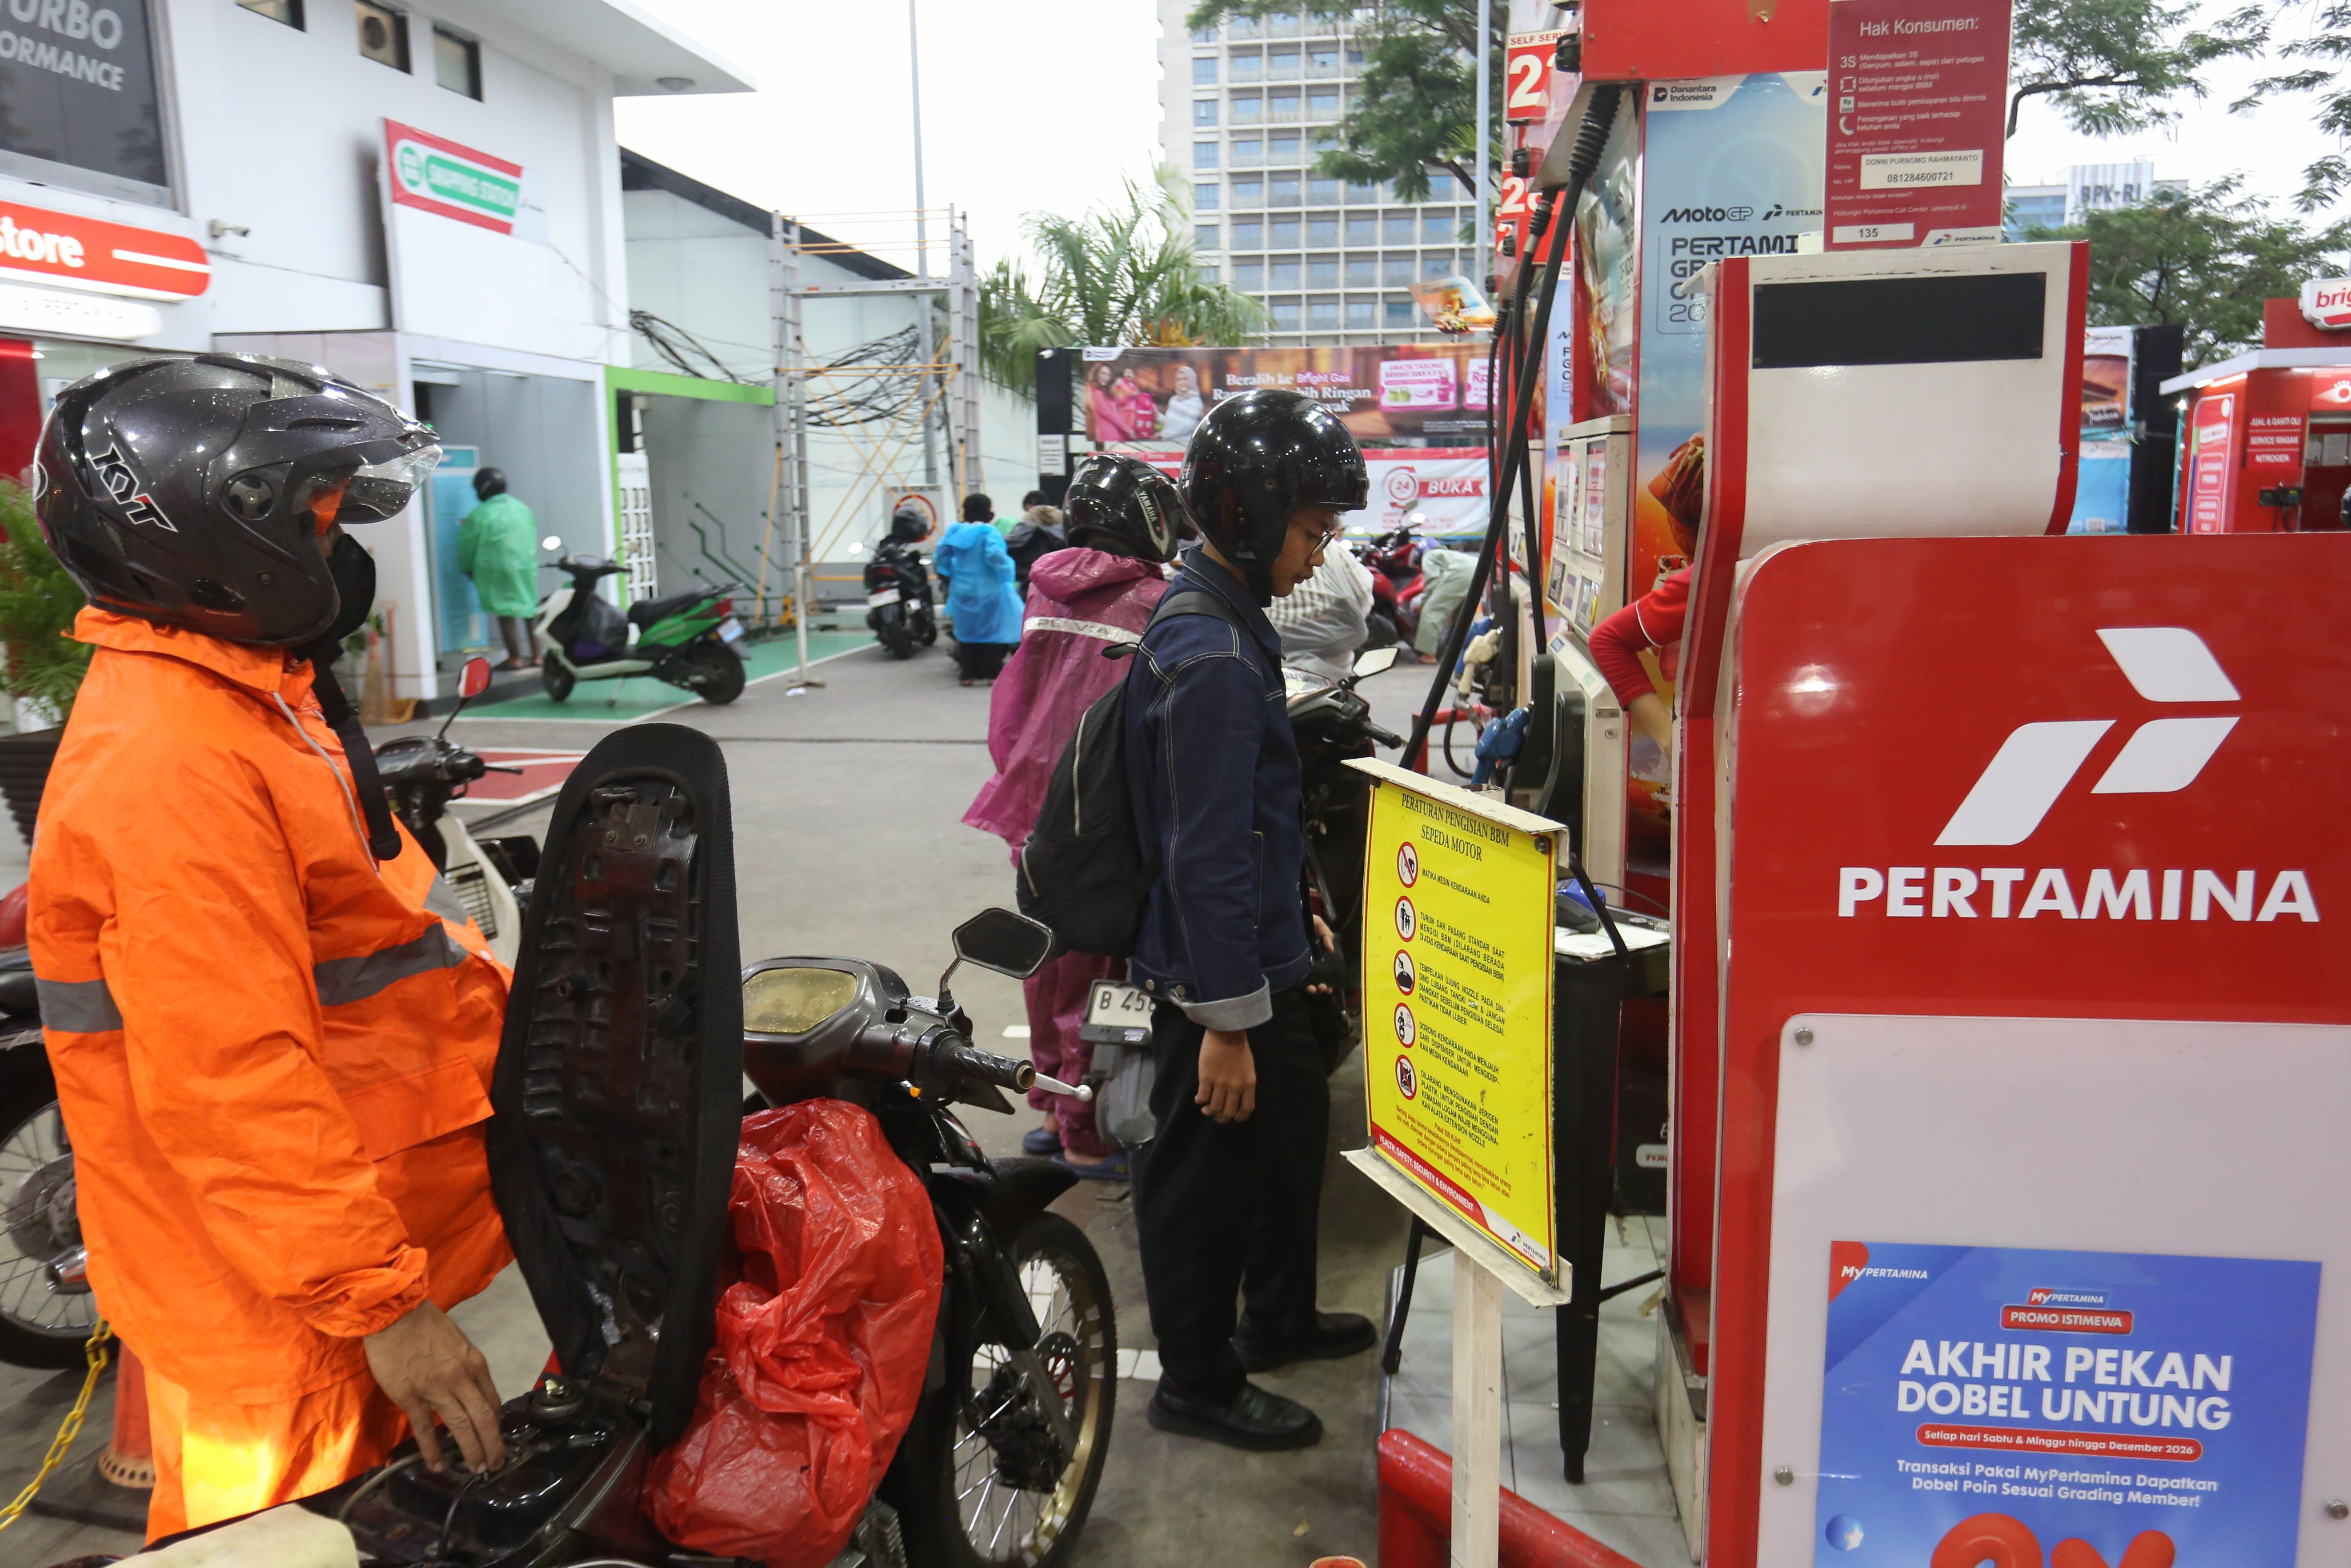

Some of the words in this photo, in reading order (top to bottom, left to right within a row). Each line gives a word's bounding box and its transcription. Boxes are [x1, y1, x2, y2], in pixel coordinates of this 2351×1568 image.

[1510, 36, 1535, 45] SELF
[1860, 20, 1889, 37] Hak
[1894, 17, 1979, 34] Konsumen:
[1840, 56, 1856, 68] 3S
[1670, 94, 1713, 102] Indonesia
[1865, 158, 1888, 166] DONNI
[2081, 183, 2140, 204] BPK-RI
[1858, 228, 1878, 238] 135
[1278, 372, 1294, 384] ke
[1322, 386, 1372, 402] Ringan
[2250, 417, 2264, 426] JUAL
[2250, 436, 2274, 445] SERVICE
[2275, 435, 2299, 444] RINGAN
[2255, 453, 2290, 463] NITROGEN
[1428, 479, 1474, 495] BUKA
[1139, 490, 1157, 522] YAMAHA
[1402, 793, 1444, 821] PERATURAN
[1445, 810, 1489, 839] PENGISIAN
[1490, 826, 1509, 847] BBM
[1421, 824, 1450, 848] SEPEDA
[1451, 836, 1482, 861] MOTOR
[1422, 868, 1437, 881] MATIKA
[1437, 875, 1450, 887] MESIN
[1450, 880, 1477, 899] KENDARAAN
[1478, 893, 1490, 904] ANDA
[1838, 866, 2320, 922] PERTAMINA
[1420, 912, 1434, 925] TURUN
[1437, 920, 1445, 930] DAN
[1448, 925, 1466, 940] PASANG
[1468, 935, 1490, 952] STANDAR
[1492, 947, 1505, 958] SAAT
[1420, 922, 1438, 938] MENGISI
[1441, 933, 1451, 944] BBM
[1454, 939, 1480, 958] (DILARANG
[1483, 953, 1504, 970] BERADA
[1424, 936, 1433, 945] ATAS
[1434, 940, 1458, 958] KENDARAAN
[1459, 952, 1469, 964] SAAT
[1470, 958, 1492, 975] PENGISIAN
[1493, 969, 1504, 983] BBM)
[1099, 991, 1112, 1010] B
[1419, 962, 1443, 981] TEMPELKAN
[1446, 976, 1460, 990] UJUNG
[1462, 985, 1479, 1000] NOZZLE
[1481, 995, 1493, 1008] PADA
[1496, 1003, 1505, 1013] DIN-
[1419, 973, 1429, 984] DING
[1431, 979, 1448, 994] LUBANG
[1450, 989, 1466, 1004] TANGKI
[1486, 1010, 1505, 1025] JANGAN
[1419, 983, 1439, 999] DIANGKAT
[1440, 995, 1460, 1012] SEBELUM
[1461, 1006, 1484, 1024] PENGISIAN
[1419, 993, 1438, 1010] PASTIKAN
[1440, 1004, 1451, 1018] TIDAK
[1452, 1012, 1467, 1026] LUBER
[1419, 1021, 1437, 1037] DORONG
[1438, 1031, 1463, 1053] KENDARAAN
[1464, 1048, 1476, 1061] ANDA
[1477, 1056, 1499, 1074] MENJAUH
[1420, 1032, 1429, 1043] DARI
[1431, 1039, 1454, 1058] DISPENSER
[1457, 1054, 1471, 1069] UNTUK
[1420, 1042, 1428, 1052] KAN
[1429, 1048, 1441, 1061] MESIN
[1442, 1056, 1468, 1077] KENDARAAN
[1421, 1070, 1441, 1088] DILARANG
[1444, 1084, 1476, 1111] MENGGUNAKAN
[1479, 1108, 1498, 1125] JERIGEN
[1440, 1092, 1454, 1108] UNTUK
[1455, 1103, 1478, 1123] PENGISIAN
[1479, 1118, 1498, 1136] DENGAN
[1422, 1090, 1441, 1108] KEMASAN
[1442, 1103, 1457, 1119] LOGAM
[1458, 1113, 1470, 1128] WAJIB
[1472, 1123, 1499, 1145] MENGGUNA-
[1431, 1107, 1444, 1120] ALATA
[1445, 1115, 1467, 1136] EXTENSION
[1469, 1131, 1486, 1148] NOZZLE
[1379, 1134, 1396, 1155] HEALTH,
[1396, 1147, 1413, 1168] SAFETY,
[1414, 1160, 1435, 1184] SECURITY
[1436, 1177, 1439, 1187] &
[1440, 1180, 1474, 1212] ENVIRONMENT
[1841, 1265, 1928, 1280] MyPERTAMINA
[2011, 1312, 2059, 1324] PROMO
[2062, 1314, 2122, 1327] ISTIMEWA
[1900, 1339, 2051, 1382] AKHIR
[2064, 1346, 2232, 1392] PEKAN
[1897, 1380, 2029, 1418] DOBEL
[2042, 1388, 2231, 1431] UNTUNG
[1925, 1431, 1957, 1441] Setiap
[1960, 1432, 1981, 1442] hari
[1983, 1433, 2013, 1443] Sabtu
[2016, 1435, 2023, 1444] &
[2026, 1436, 2066, 1448] Minggu
[2068, 1438, 2106, 1450] hingga
[2109, 1441, 2163, 1452] Desember
[2166, 1444, 2193, 1454] 2026
[1897, 1460, 1970, 1475] Transaksi
[1975, 1465, 2020, 1478] Pakai
[2024, 1468, 2131, 1486] MyPertamina
[2136, 1474, 2218, 1492] Dapatkan
[1912, 1478, 1958, 1491] Dobel
[1963, 1481, 1997, 1494] Poin
[2001, 1483, 2053, 1498] Sesuai
[2057, 1487, 2123, 1504] Grading
[2127, 1491, 2200, 1507] Member!
